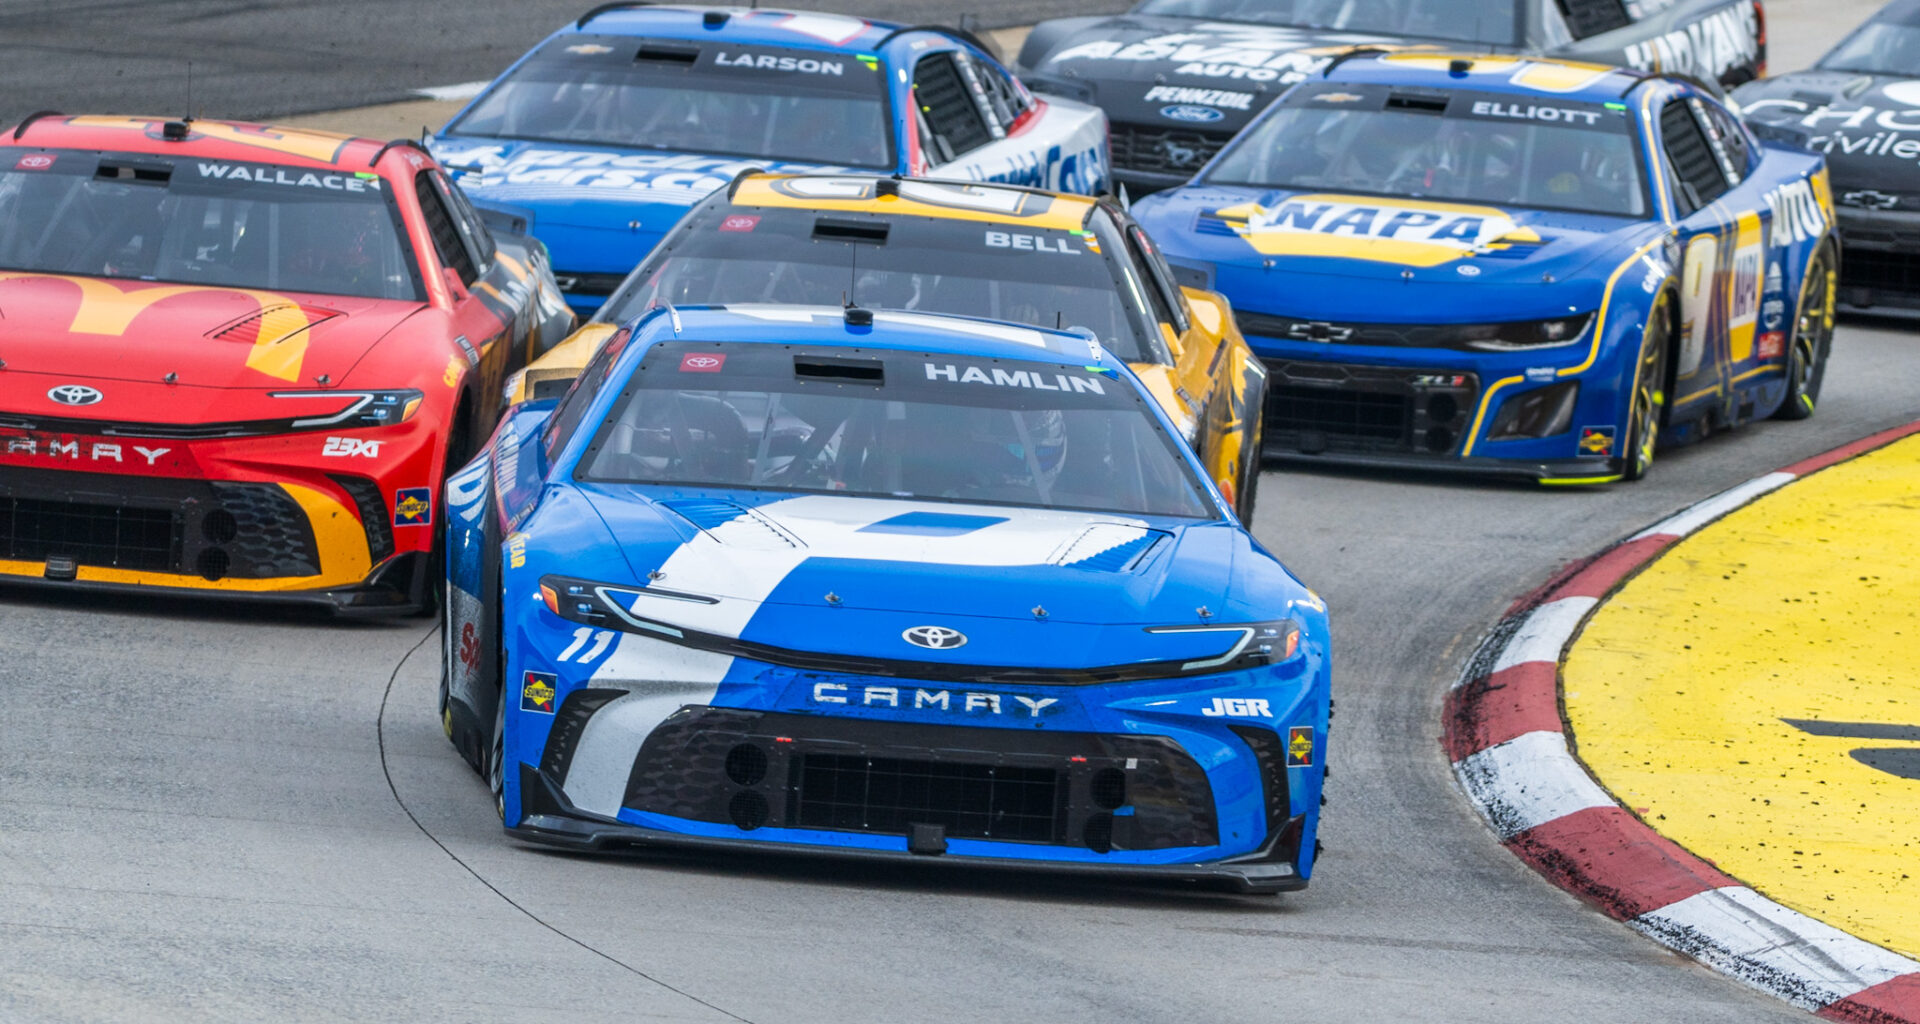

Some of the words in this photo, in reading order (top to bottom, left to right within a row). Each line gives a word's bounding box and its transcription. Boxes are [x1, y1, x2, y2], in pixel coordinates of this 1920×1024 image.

[714, 51, 844, 76] LARSON
[1174, 62, 1279, 81] AUTO
[1144, 85, 1255, 110] PENNZOIL
[1167, 106, 1218, 119] Ford
[1472, 101, 1602, 126] ELLIOTT
[198, 163, 366, 193] WALLACE
[1265, 202, 1484, 240] NAPA
[985, 231, 1083, 255] BELL
[924, 363, 1106, 395] HAMLIN
[396, 501, 429, 514] SUNOCO
[556, 627, 616, 664] 11
[524, 685, 555, 701] SUNOCO
[813, 683, 1058, 717] CAMRY
[1202, 698, 1273, 717] JGR
